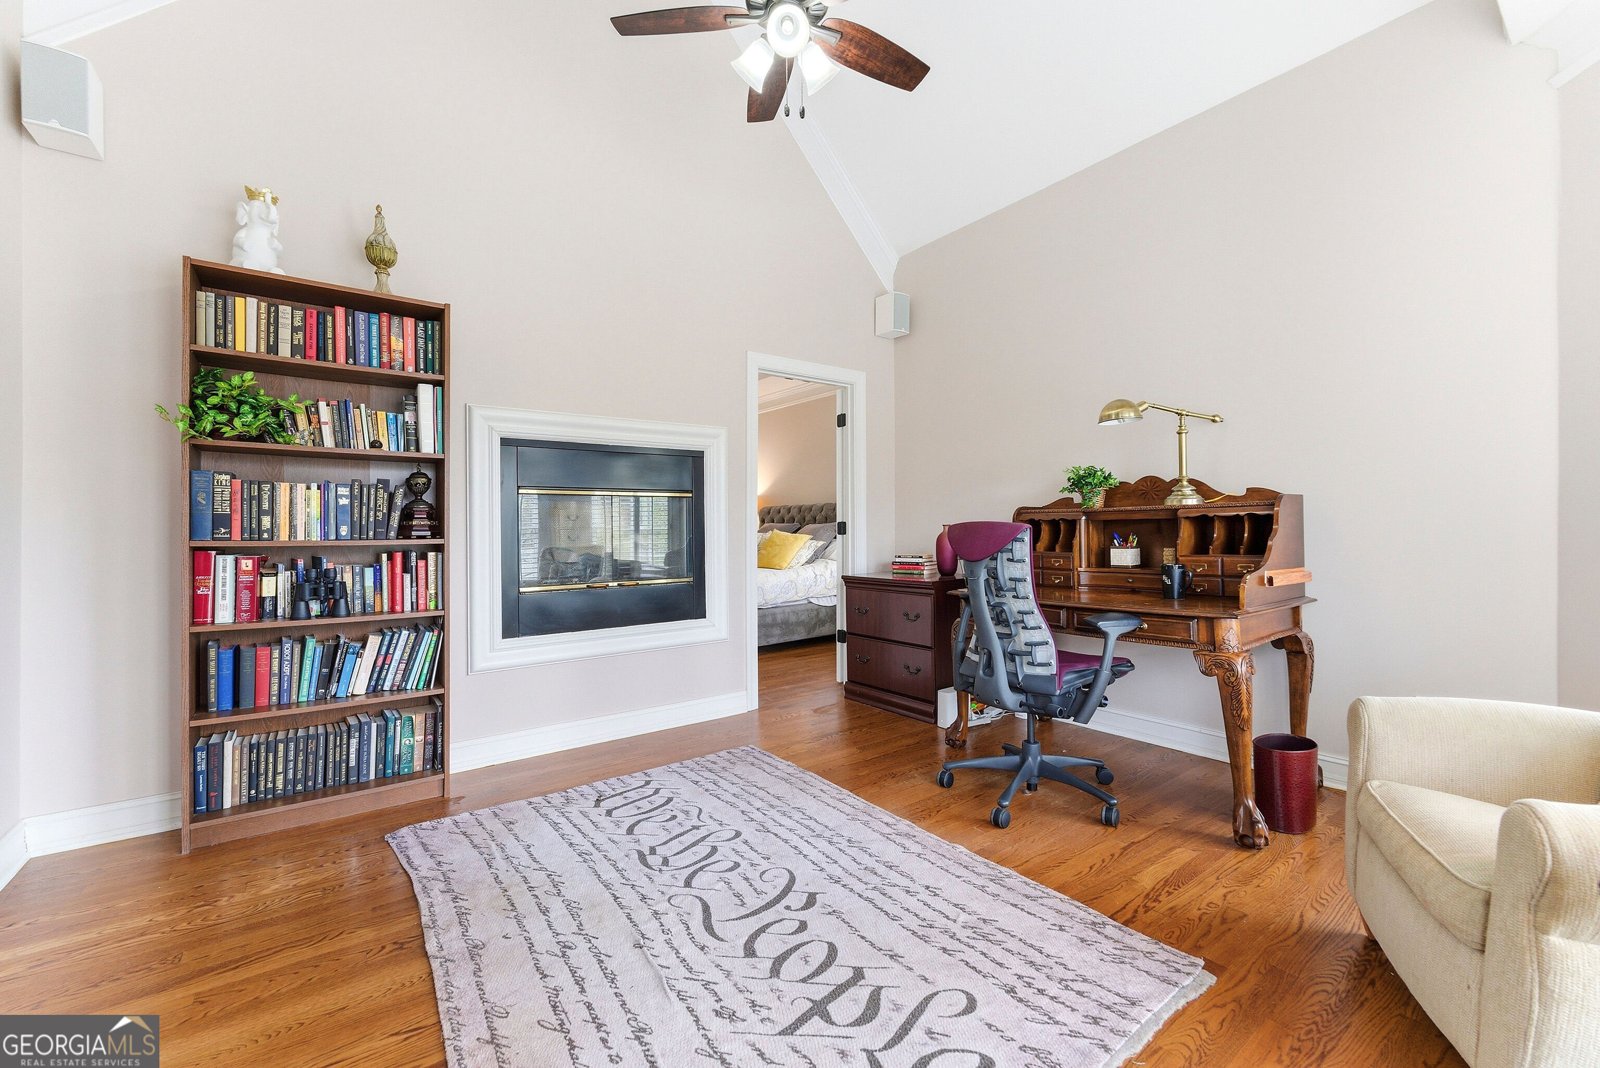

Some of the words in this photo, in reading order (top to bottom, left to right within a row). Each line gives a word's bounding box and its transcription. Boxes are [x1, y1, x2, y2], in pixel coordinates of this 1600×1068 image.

[594, 779, 676, 836] We
[633, 823, 743, 890] the
[613, 992, 636, 1016] and
[607, 1052, 623, 1065] to
